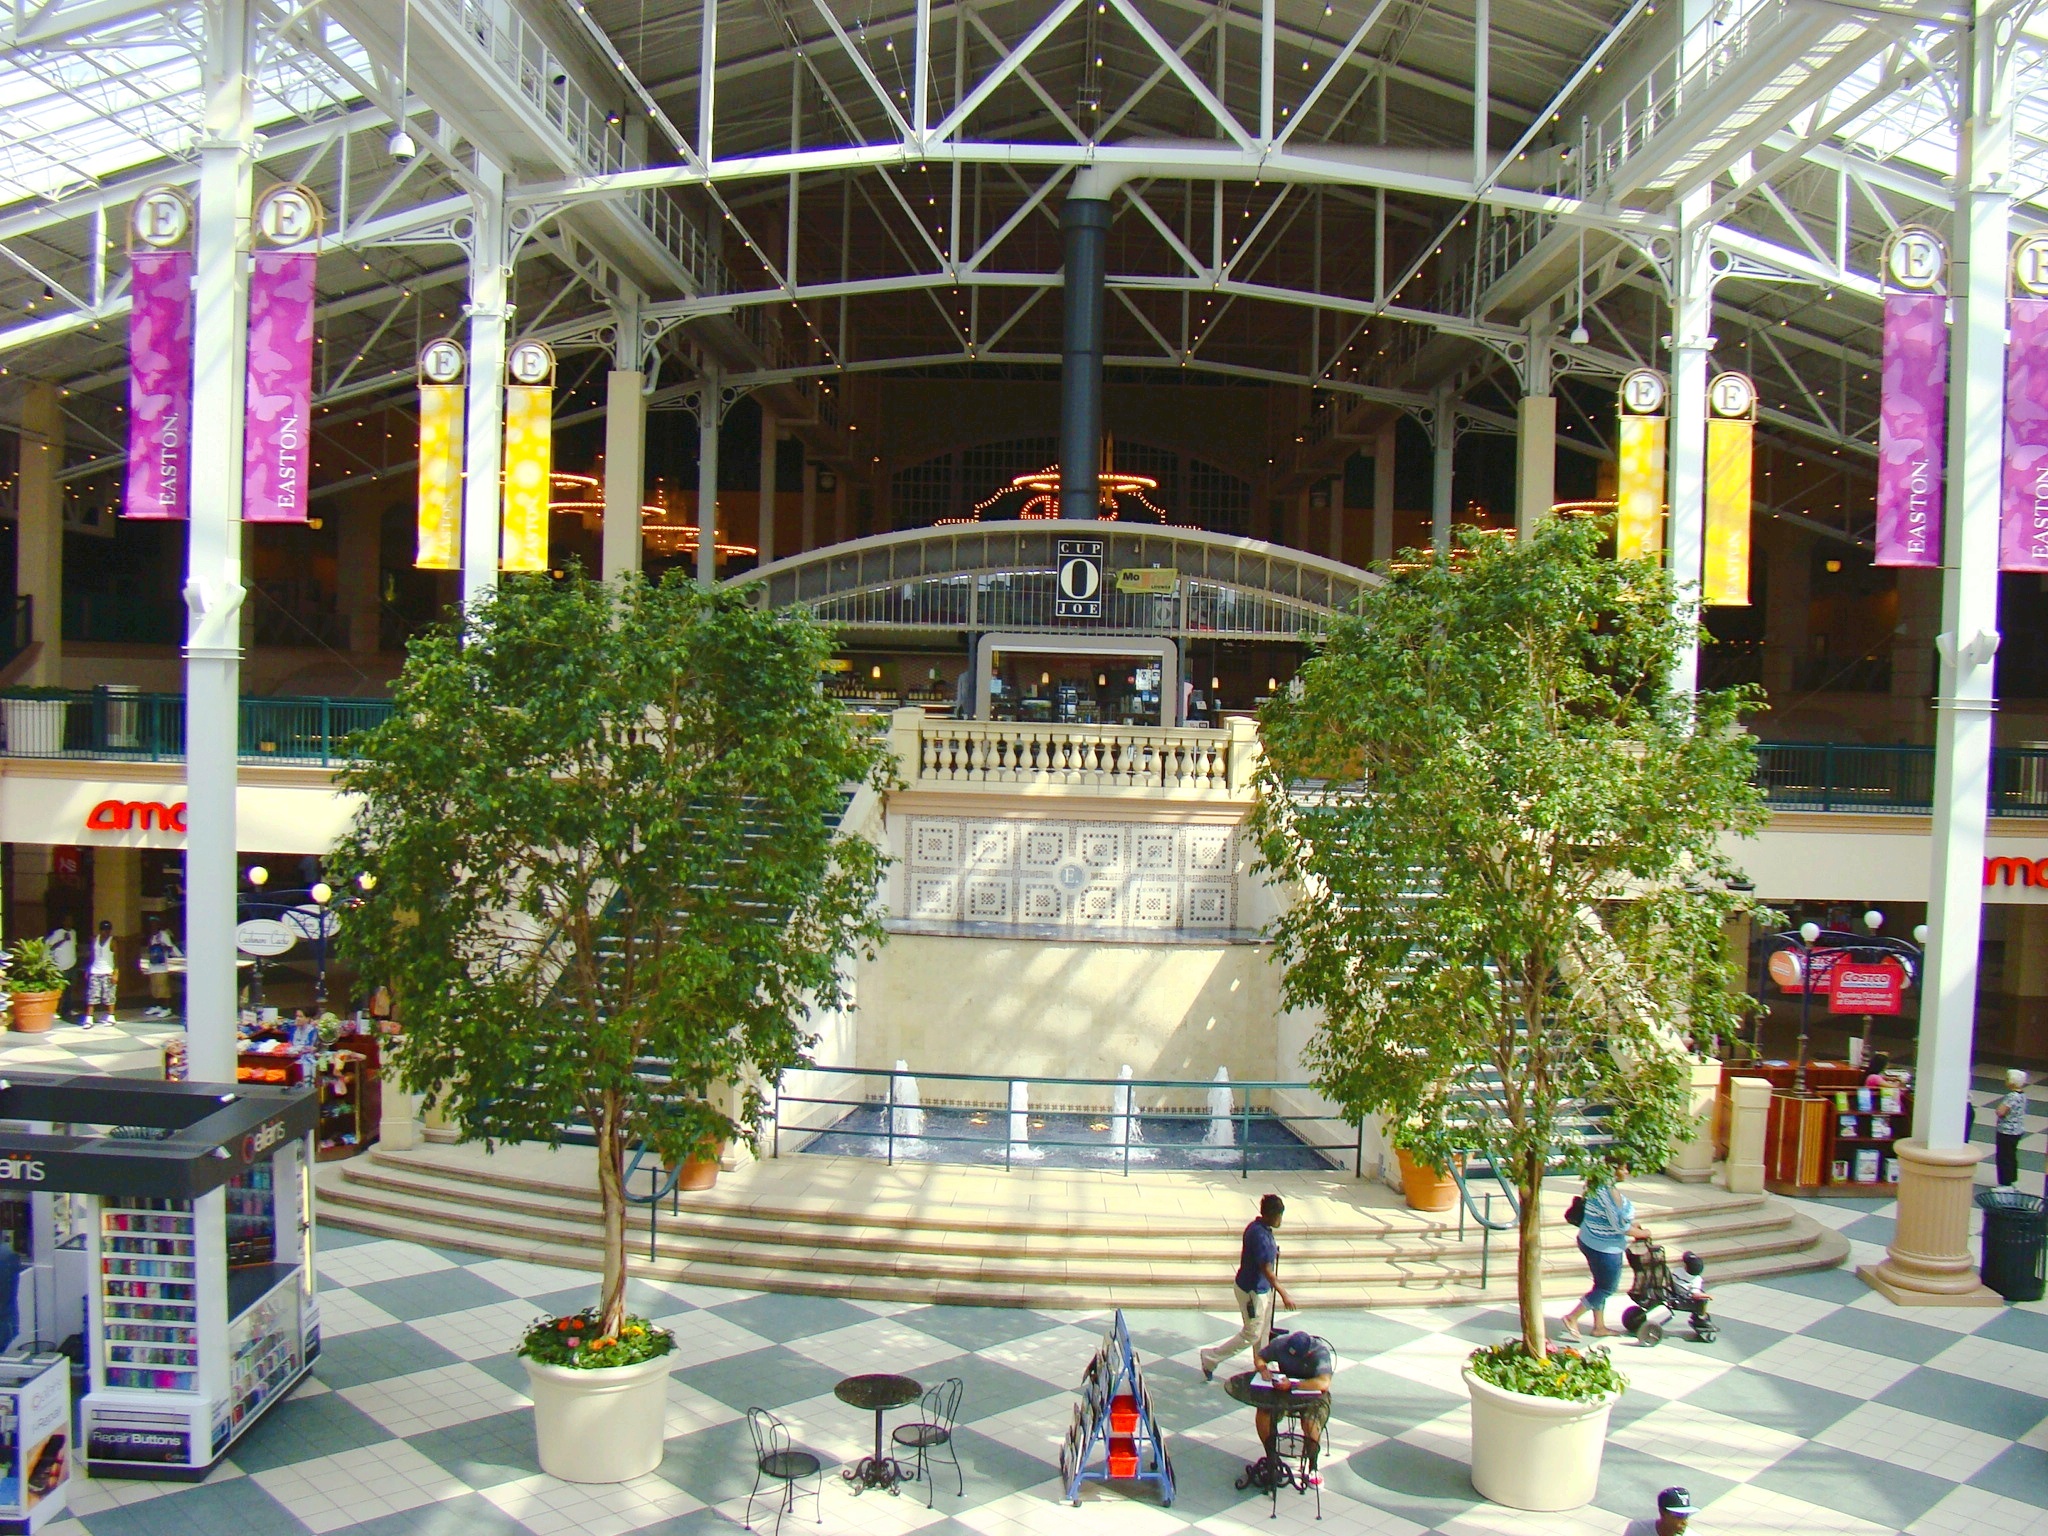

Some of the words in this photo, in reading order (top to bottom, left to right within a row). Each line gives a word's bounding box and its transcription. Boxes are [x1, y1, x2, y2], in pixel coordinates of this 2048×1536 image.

[147, 200, 177, 238] E
[271, 200, 302, 237] E
[1901, 241, 1934, 279] E
[433, 350, 455, 376] E
[520, 351, 541, 377] E
[1632, 380, 1656, 407] E
[1720, 384, 1742, 410] E
[1060, 543, 1101, 554] CUP
[1060, 558, 1099, 600] O
[1059, 603, 1098, 614] JOE
[93, 1431, 131, 1444] Repair
[132, 1432, 181, 1446] Buttons
